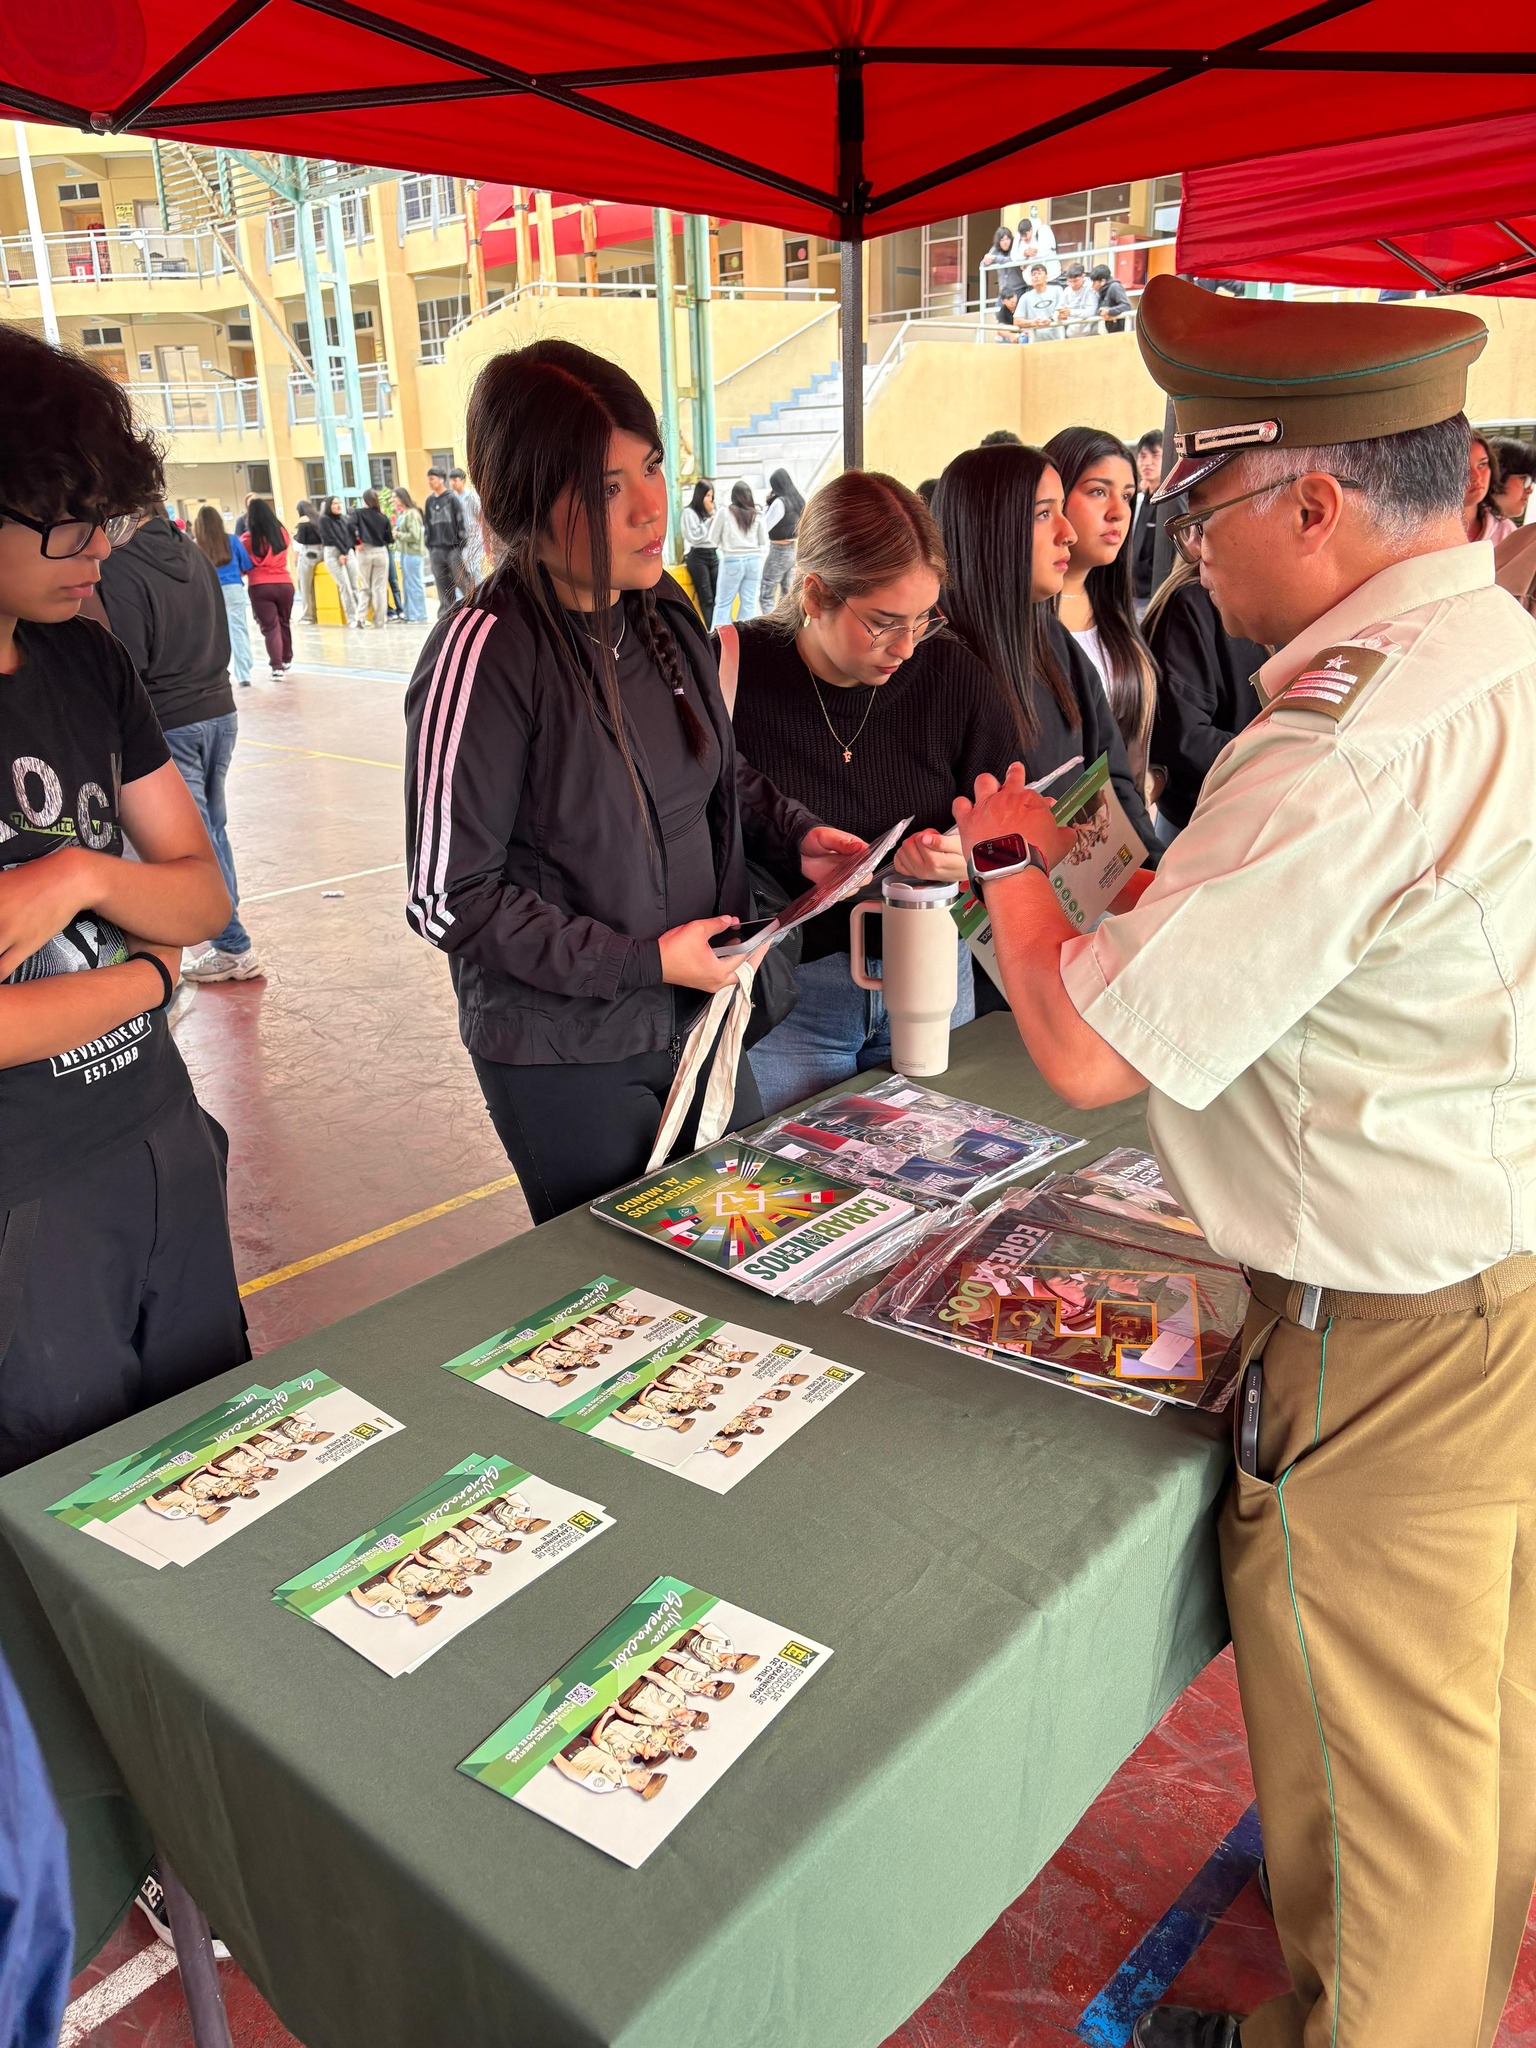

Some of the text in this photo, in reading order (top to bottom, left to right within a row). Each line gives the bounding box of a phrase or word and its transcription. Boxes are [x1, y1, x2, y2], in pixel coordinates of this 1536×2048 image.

[60, 1016, 144, 1067] NEVER GIVE UP
[658, 1177, 679, 1186] AL
[613, 1186, 665, 1212] MUNDO
[625, 1176, 706, 1218] INTEGRADOS
[742, 1199, 890, 1279] CARABINEROS
[934, 1223, 1046, 1326] EGRESADOS
[549, 1282, 607, 1323] Generación
[581, 1291, 606, 1310] Nueva
[677, 1327, 699, 1348] Nueva
[213, 1390, 286, 1442] Generación
[252, 1402, 283, 1426] Nueva
[420, 1465, 497, 1526] Generación
[461, 1479, 494, 1507] Nueva
[530, 1525, 573, 1554] CARABINEROS
[539, 1528, 559, 1541] CHILE
[547, 1532, 584, 1557] ESCUELA DE
[332, 1563, 351, 1575] TODO
[349, 1546, 378, 1564] DURANTE
[534, 1551, 545, 1559] DE
[310, 1578, 327, 1589] AÑO
[314, 1548, 382, 1591] POSTULACIONES ABIERTAS
[608, 1590, 681, 1670] Generación
[650, 1607, 682, 1644] Nueva
[748, 1660, 788, 1699] CARABINEROS
[753, 1657, 780, 1682] DE CHILE
[754, 1664, 796, 1705] FORMACIÓN DE
[769, 1668, 803, 1701] ESCUELA DE
[541, 1699, 570, 1725] DURANTE
[510, 1703, 576, 1763] POSTULACIONES ABIERTAS
[524, 1723, 544, 1740] TODO
[503, 1745, 522, 1760] AÑO
